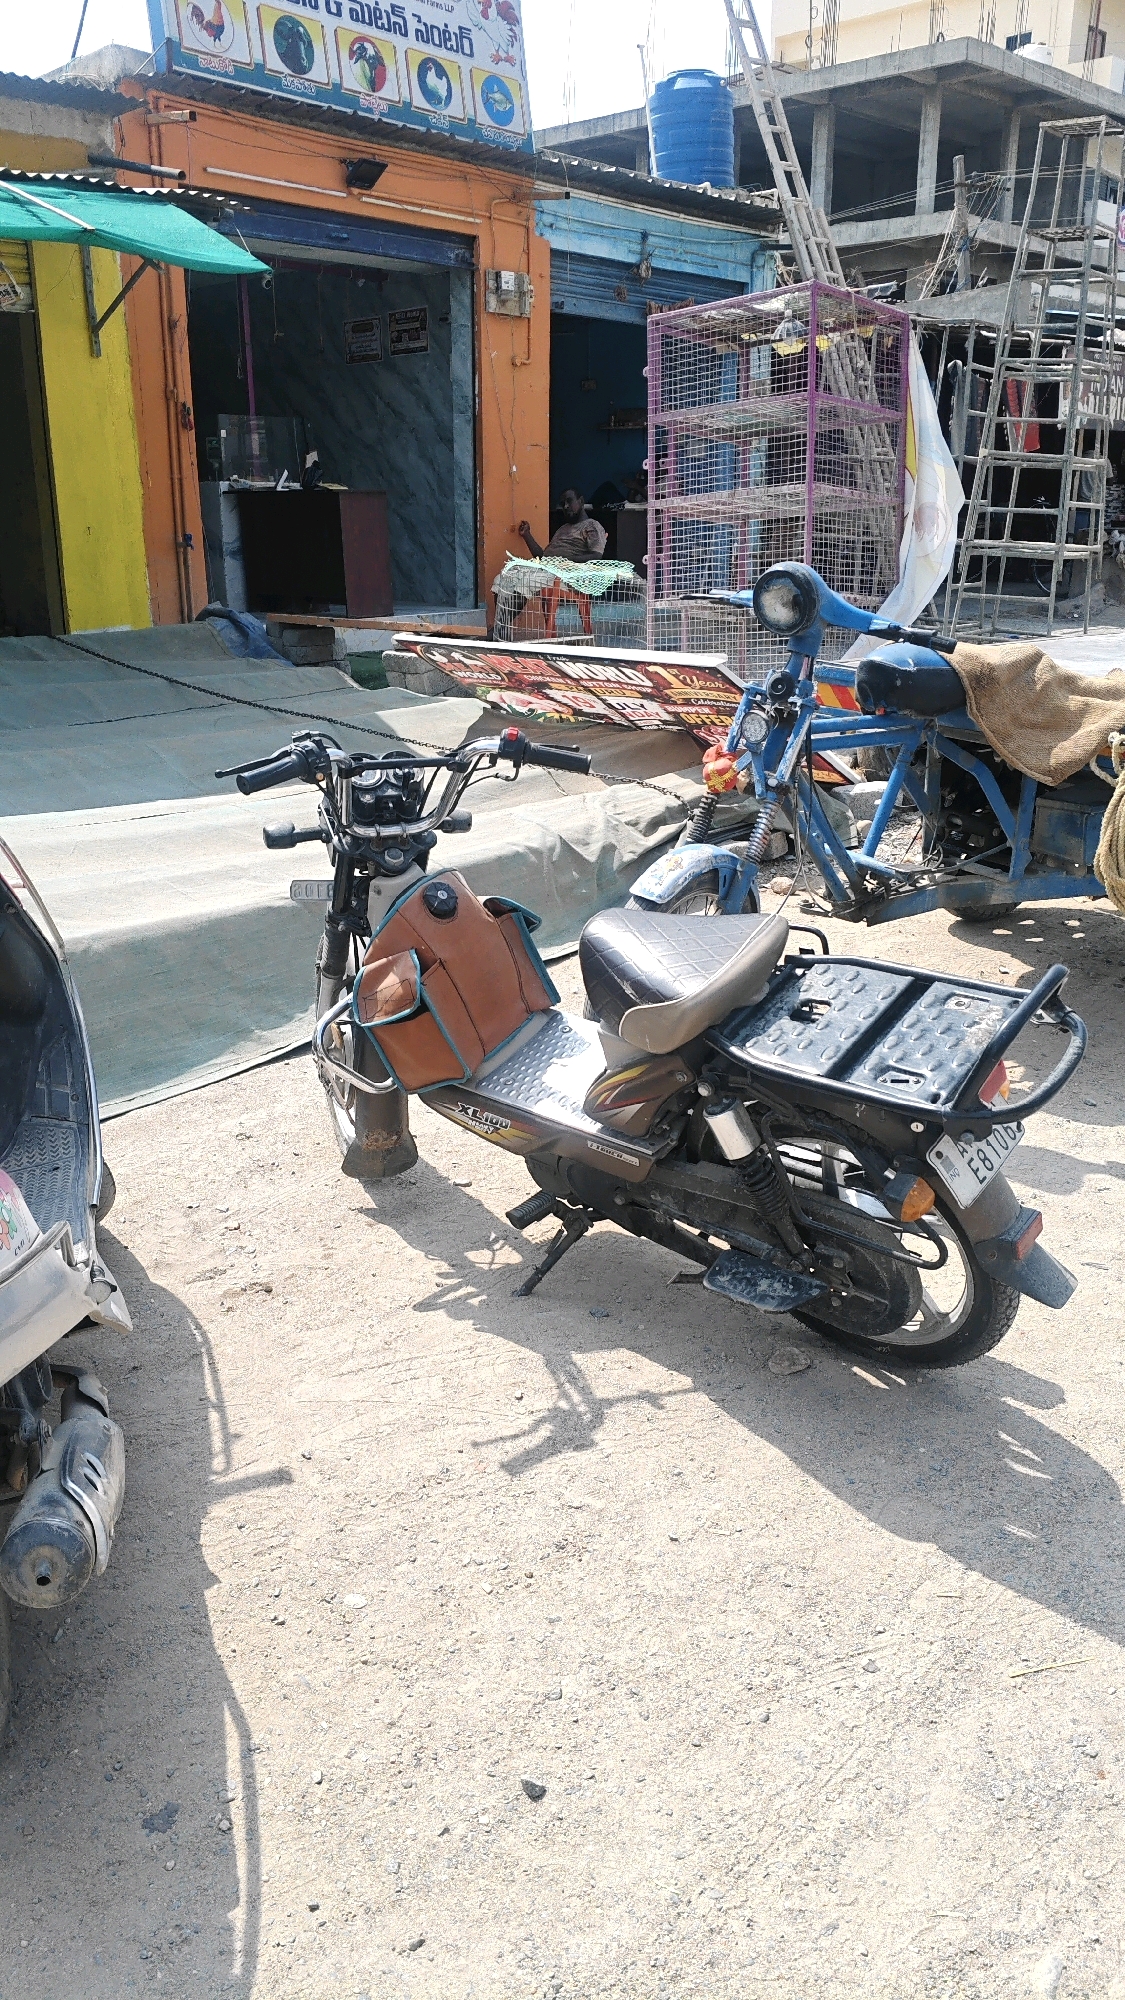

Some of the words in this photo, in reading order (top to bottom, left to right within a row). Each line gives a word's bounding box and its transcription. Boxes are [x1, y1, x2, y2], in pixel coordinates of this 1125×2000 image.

[412, 12, 475, 58] సెంటర్
[452, 670, 502, 680] WORLD
[476, 653, 561, 677] MEAT
[547, 660, 653, 688] WORLD
[679, 675, 727, 690] Year
[671, 689, 738, 701] ANNIVERSARY
[664, 705, 713, 714] BUMPER
[680, 713, 736, 726] OFFER
